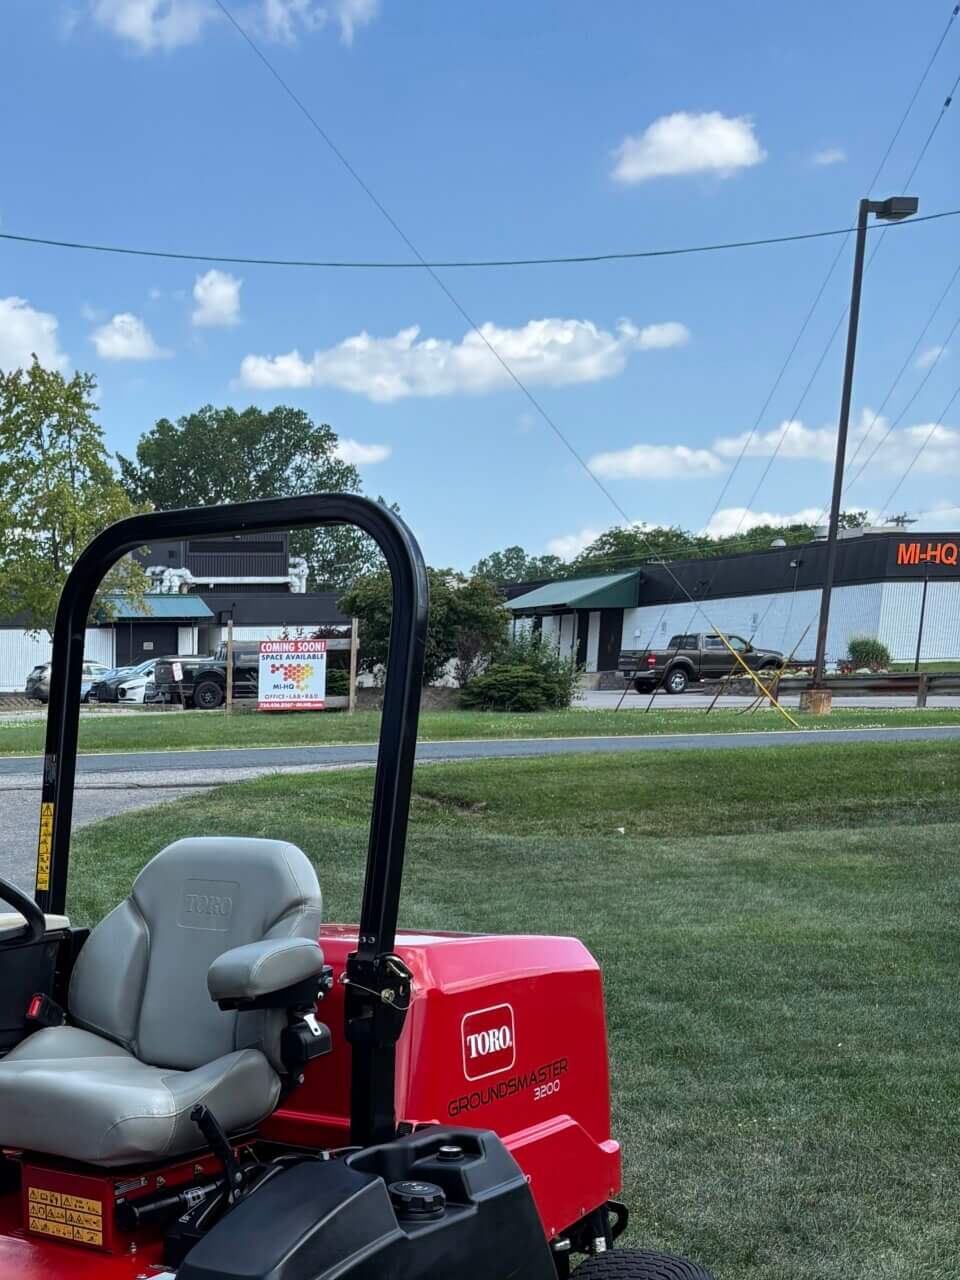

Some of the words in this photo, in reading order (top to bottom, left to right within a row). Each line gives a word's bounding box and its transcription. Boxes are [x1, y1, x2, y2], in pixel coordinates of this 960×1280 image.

[897, 543, 958, 565] MI-HQ
[261, 642, 295, 652] COMING
[297, 641, 325, 652] SOON!
[183, 893, 233, 914] TORO
[465, 1025, 511, 1058] TORO
[447, 1057, 569, 1117] GROUNDSMASTER
[533, 1079, 561, 1101] 3200
